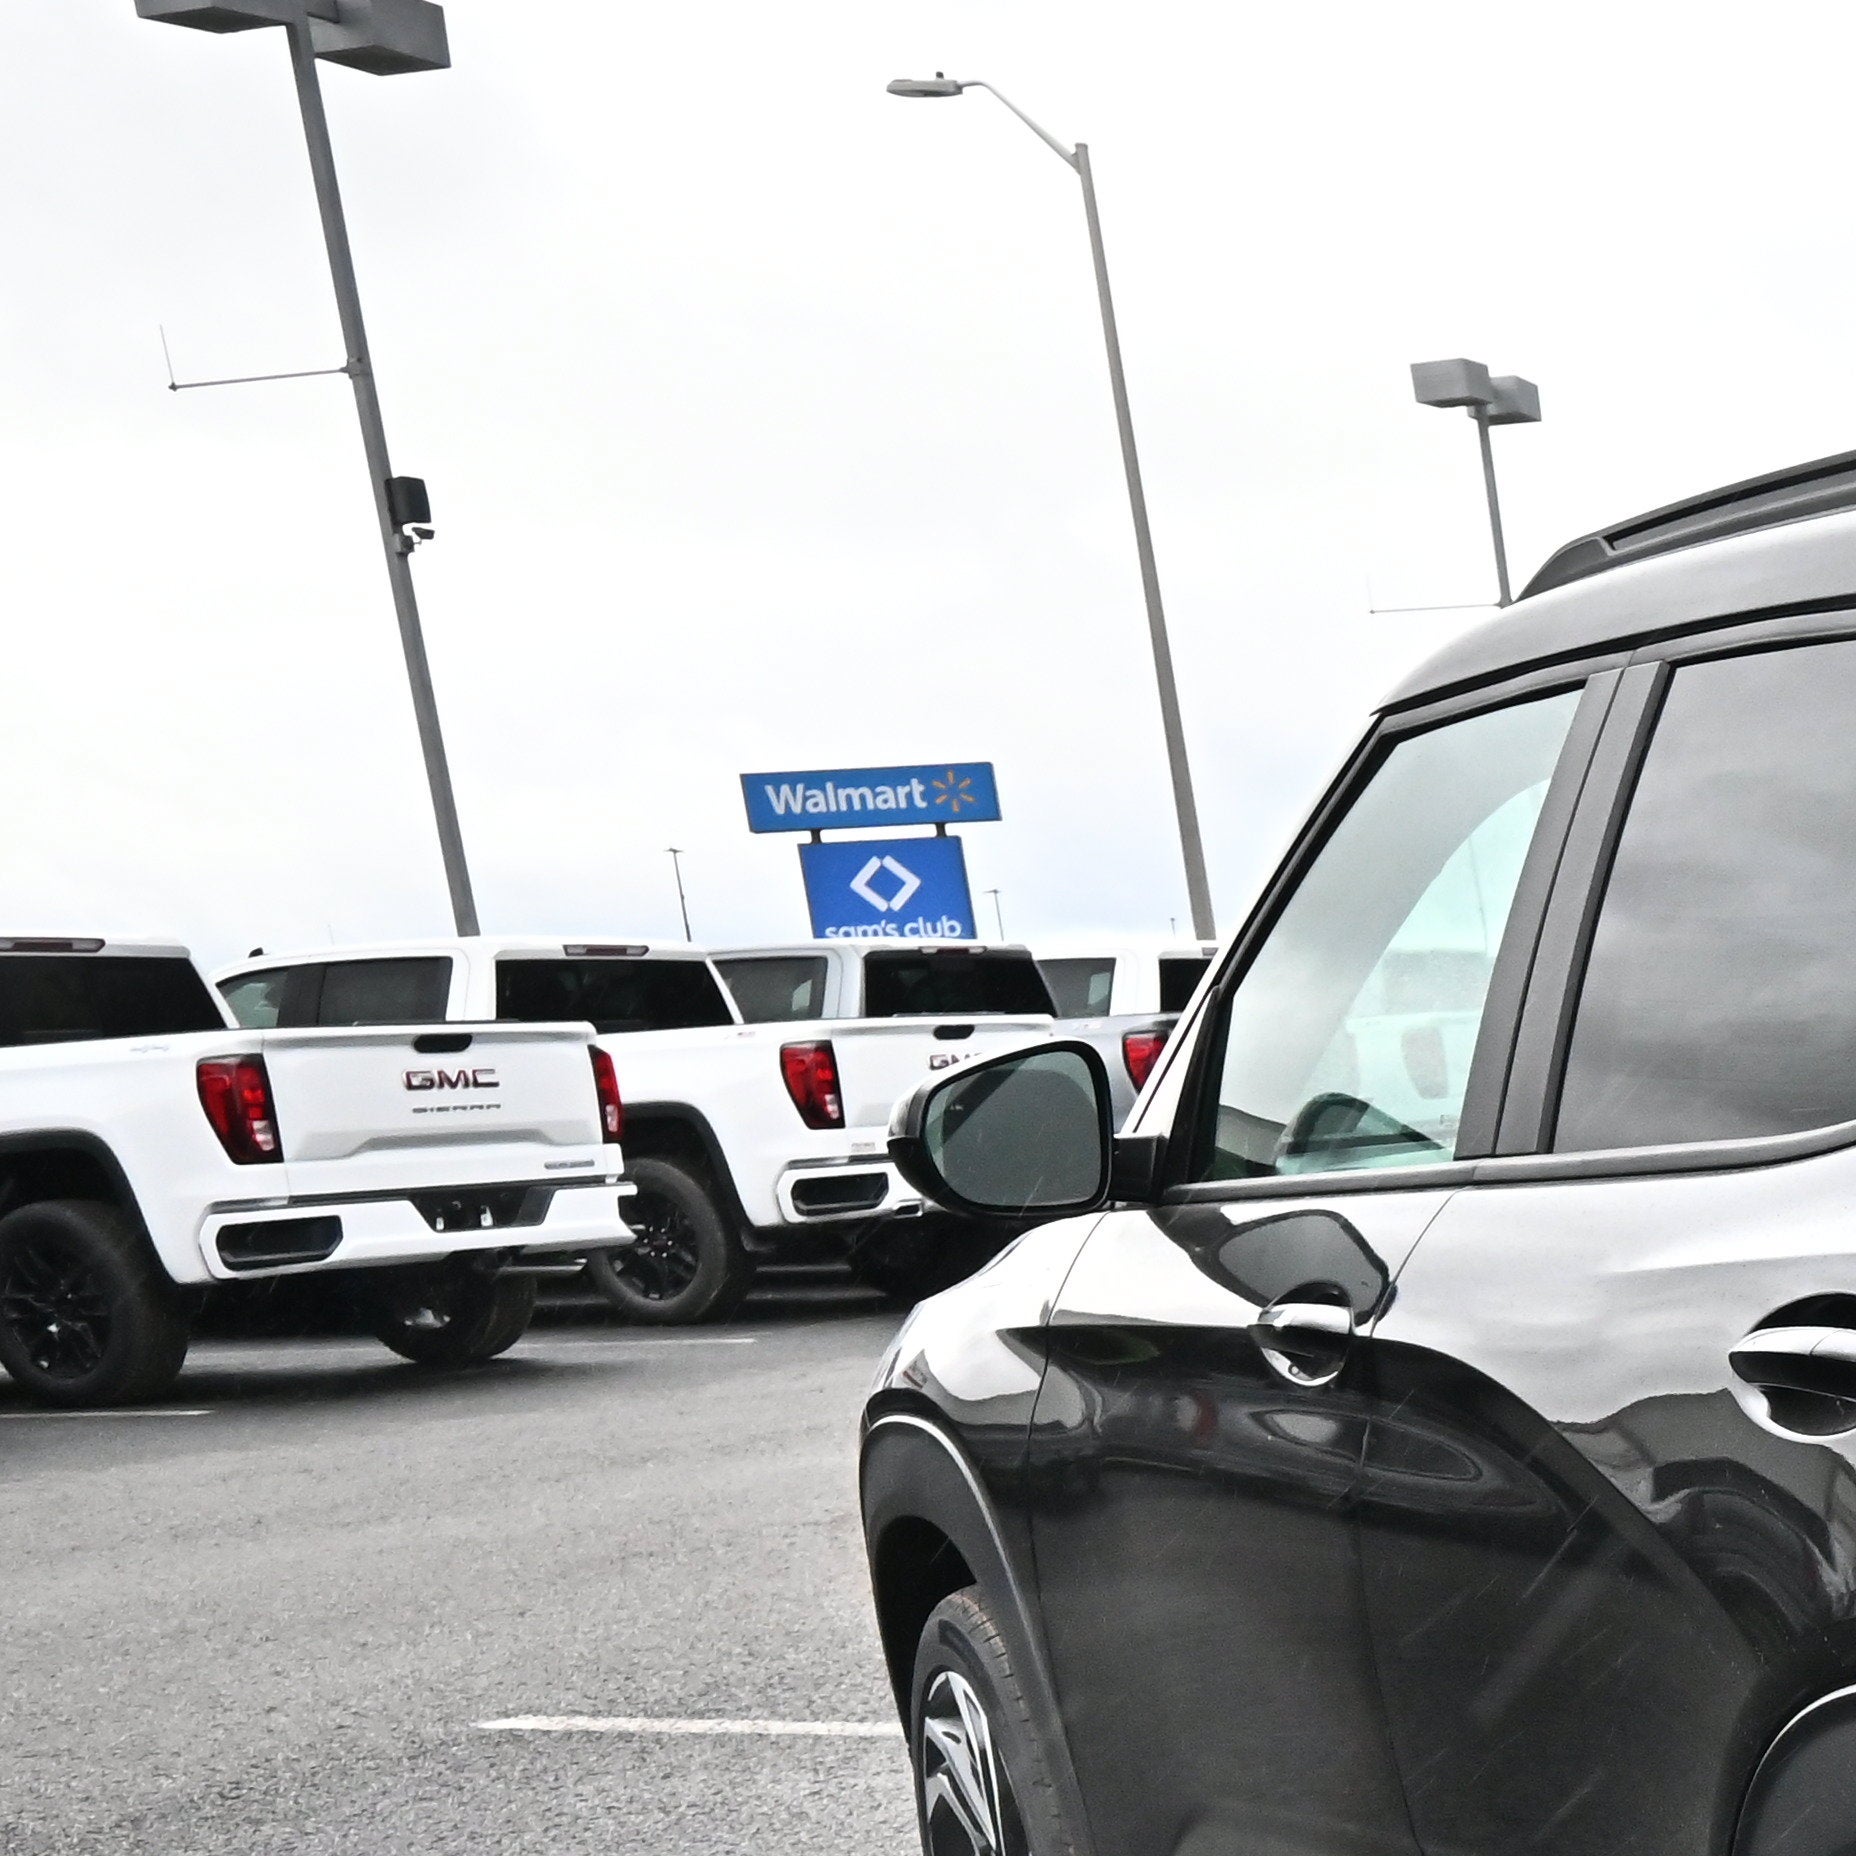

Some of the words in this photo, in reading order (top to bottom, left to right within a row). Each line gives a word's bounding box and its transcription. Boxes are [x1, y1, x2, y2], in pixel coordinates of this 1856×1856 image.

[764, 778, 928, 815] Walmart
[824, 919, 899, 938] sam's
[903, 915, 963, 938] club
[405, 1068, 500, 1091] GMC
